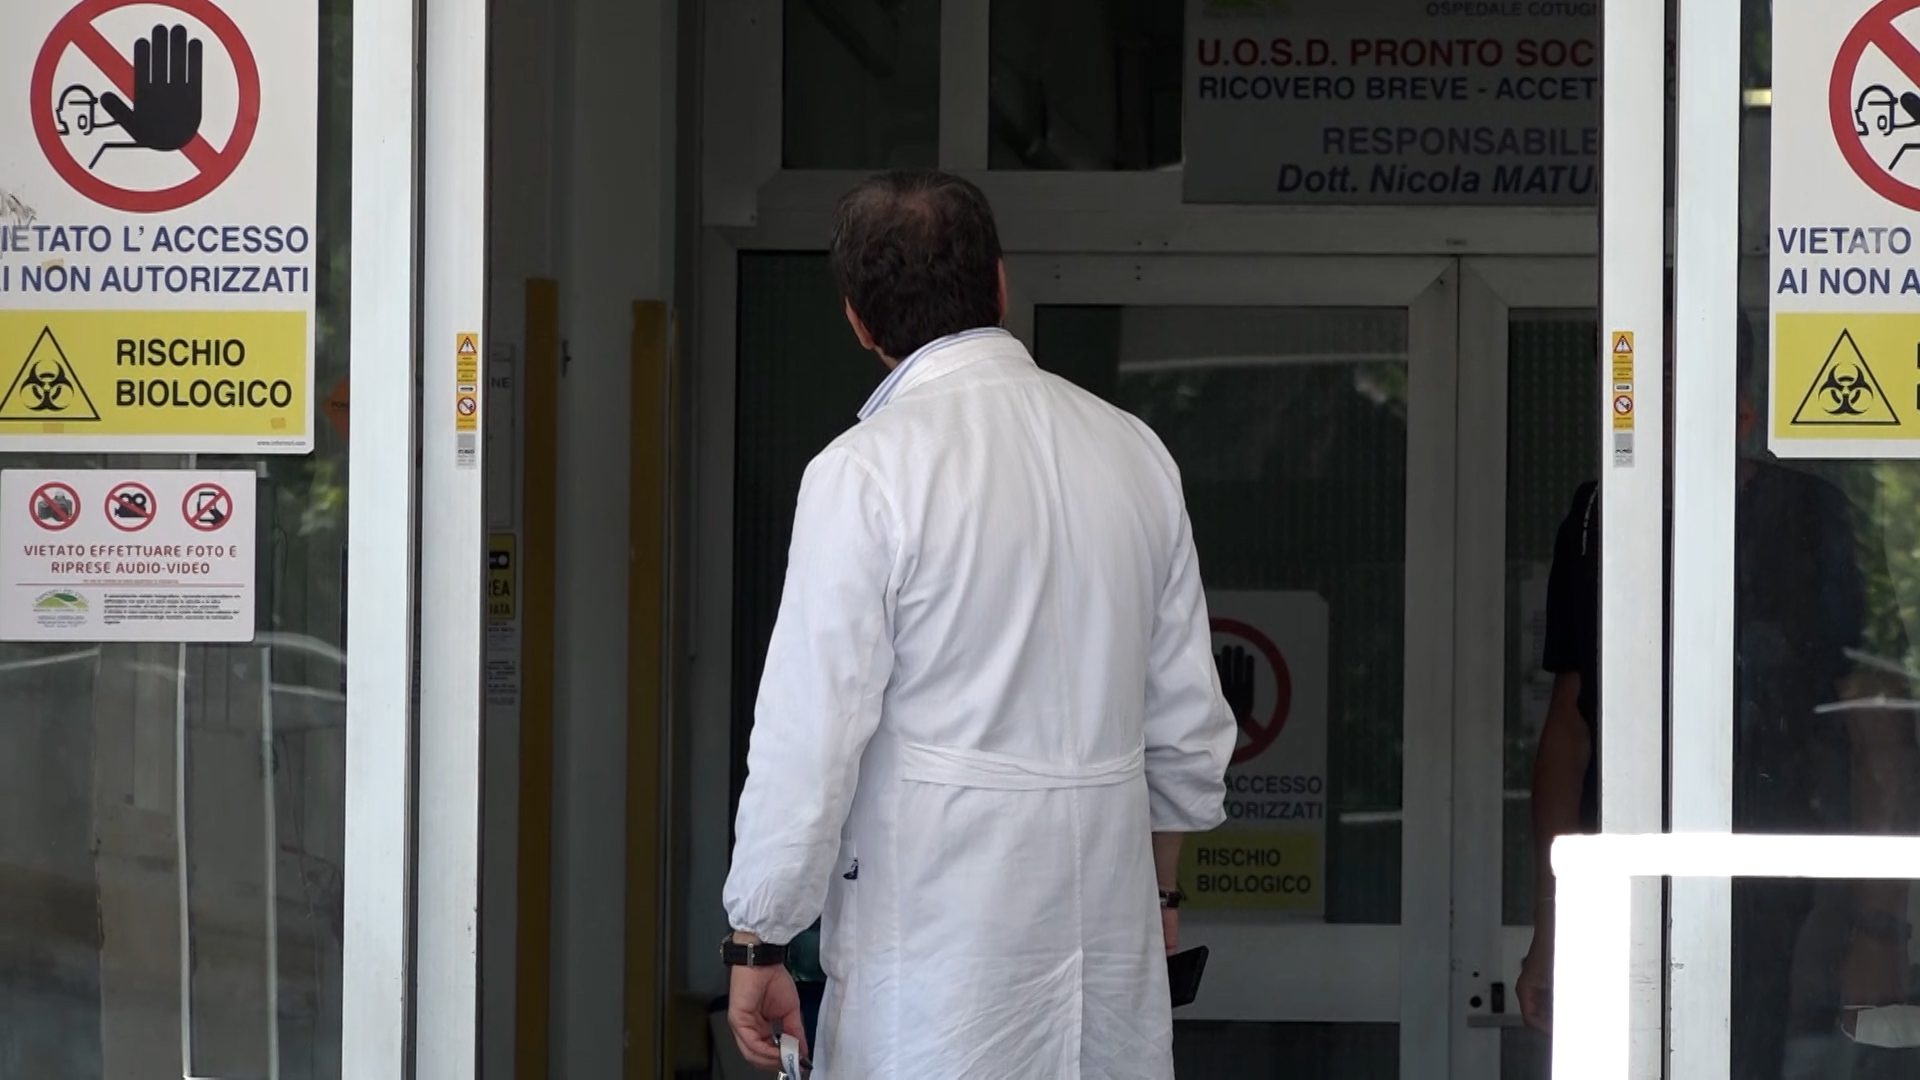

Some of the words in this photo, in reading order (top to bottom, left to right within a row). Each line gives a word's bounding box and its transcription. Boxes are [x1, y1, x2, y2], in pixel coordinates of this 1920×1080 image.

[1425, 0, 1522, 17] OSPEDALE
[1197, 37, 1337, 67] U.O.S.D.
[1350, 38, 1504, 68] PRONTO
[1515, 38, 1594, 68] SOC
[1199, 75, 1356, 101] RICOVERO
[1366, 76, 1468, 101] BREVE
[1322, 126, 1598, 156] RESPONSABILE
[1276, 163, 1359, 194] Dott.
[1369, 164, 1481, 194] Nicola
[1491, 164, 1598, 195] MATU
[0, 225, 112, 254] IETATO
[151, 225, 309, 254] ACCESSO
[1777, 226, 1912, 255] VIETATO
[0, 265, 10, 292] I
[21, 264, 91, 293] NON
[100, 265, 309, 293] AUTORIZZATI
[1777, 267, 1808, 295] AI
[1819, 267, 1891, 295] NON
[116, 338, 246, 367] RISCHIO
[116, 379, 292, 408] BIOLOGICO
[23, 544, 86, 557] VIETATO
[89, 544, 181, 558] EFFETTUARE
[186, 544, 225, 558] FOTO
[229, 545, 237, 558] E
[51, 561, 111, 574] RIPRESE
[115, 561, 210, 575] AUDIO-VIDEO
[488, 578, 511, 599] EA
[1197, 847, 1281, 867] RISCHIO
[1196, 873, 1312, 894] BIOLOGICO
